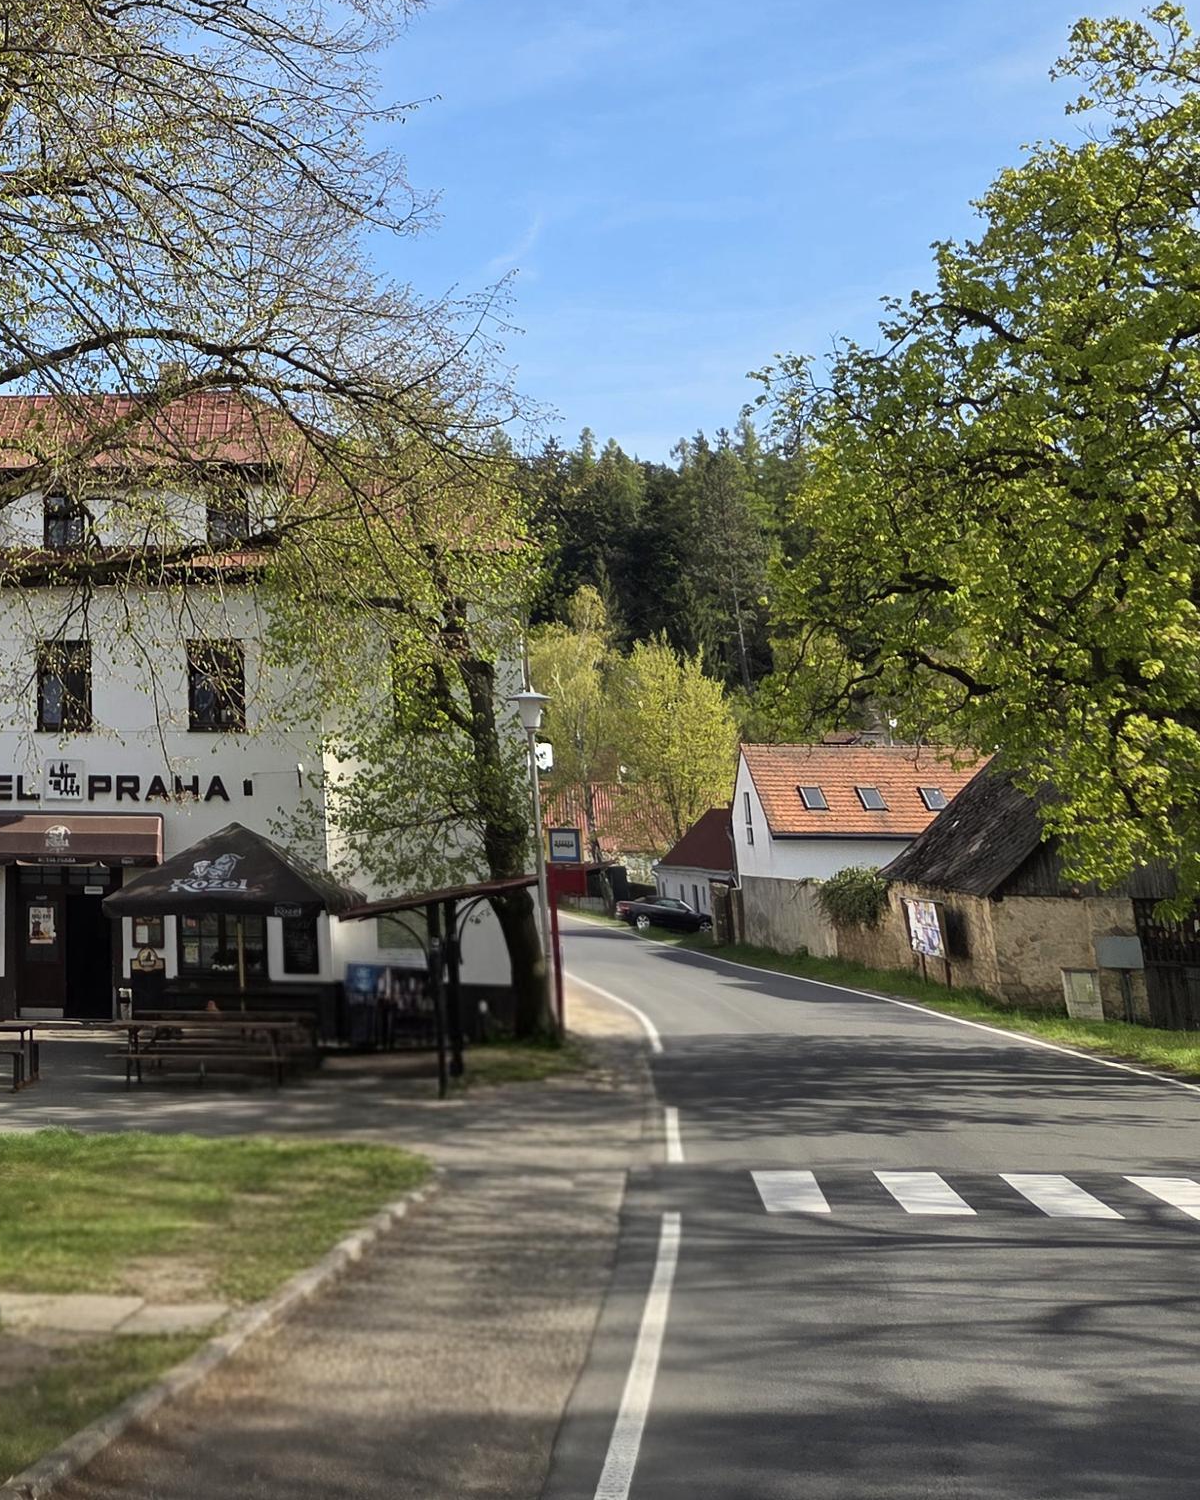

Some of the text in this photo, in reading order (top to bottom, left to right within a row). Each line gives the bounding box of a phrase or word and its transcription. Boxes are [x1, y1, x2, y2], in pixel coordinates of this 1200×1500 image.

[88, 775, 230, 801] PRAHA
[168, 879, 248, 893] Kozel
[274, 906, 302, 918] Kozel
